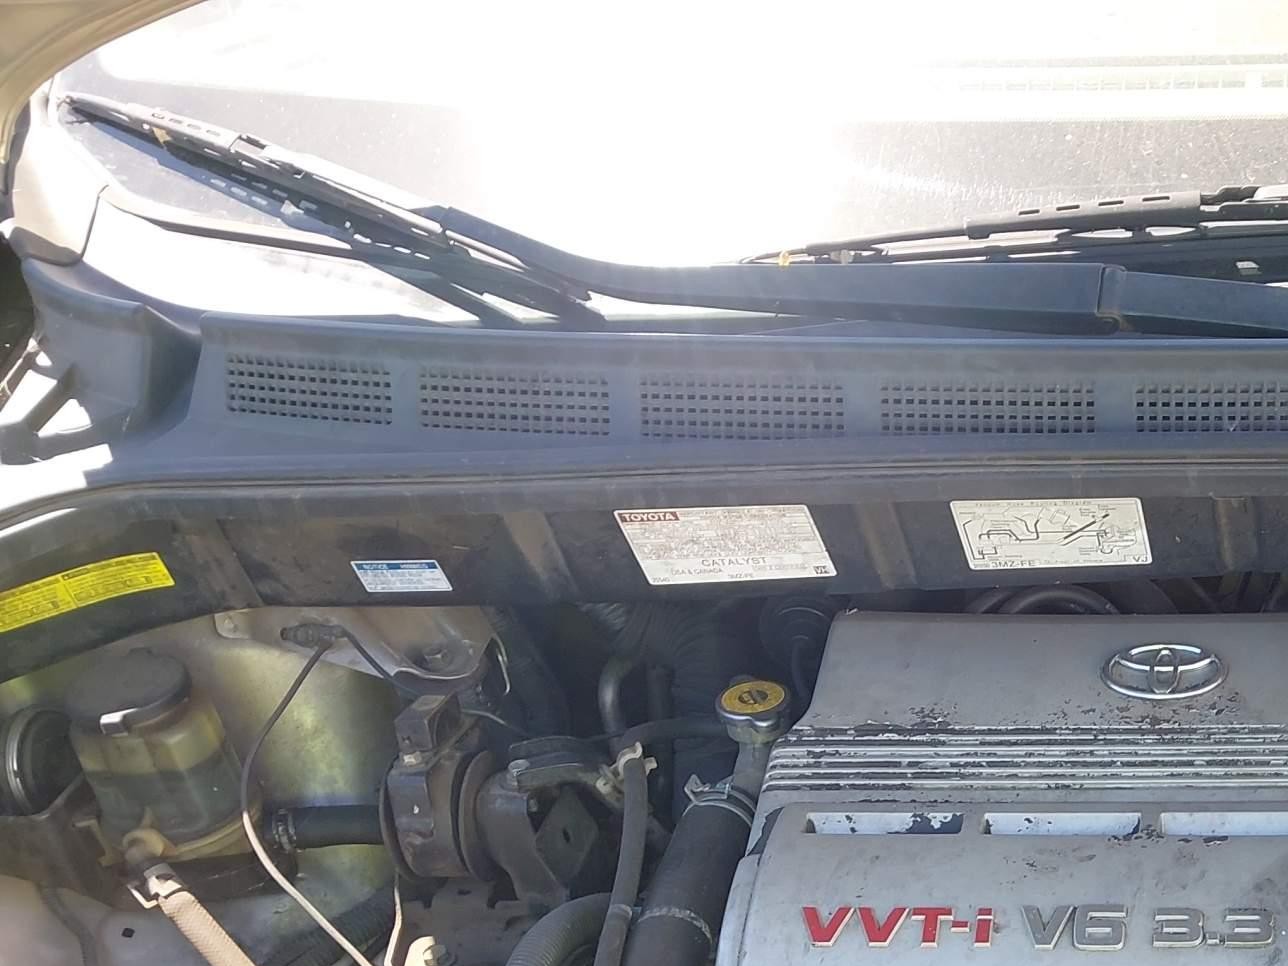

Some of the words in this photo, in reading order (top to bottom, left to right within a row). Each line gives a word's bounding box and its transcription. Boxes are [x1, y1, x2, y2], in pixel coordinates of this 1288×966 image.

[621, 512, 676, 522] TOYOTA
[701, 556, 768, 567] CATALYST
[802, 905, 995, 948] VVT-i
[1021, 904, 1129, 951] V6
[1152, 905, 1277, 950] 3.3
